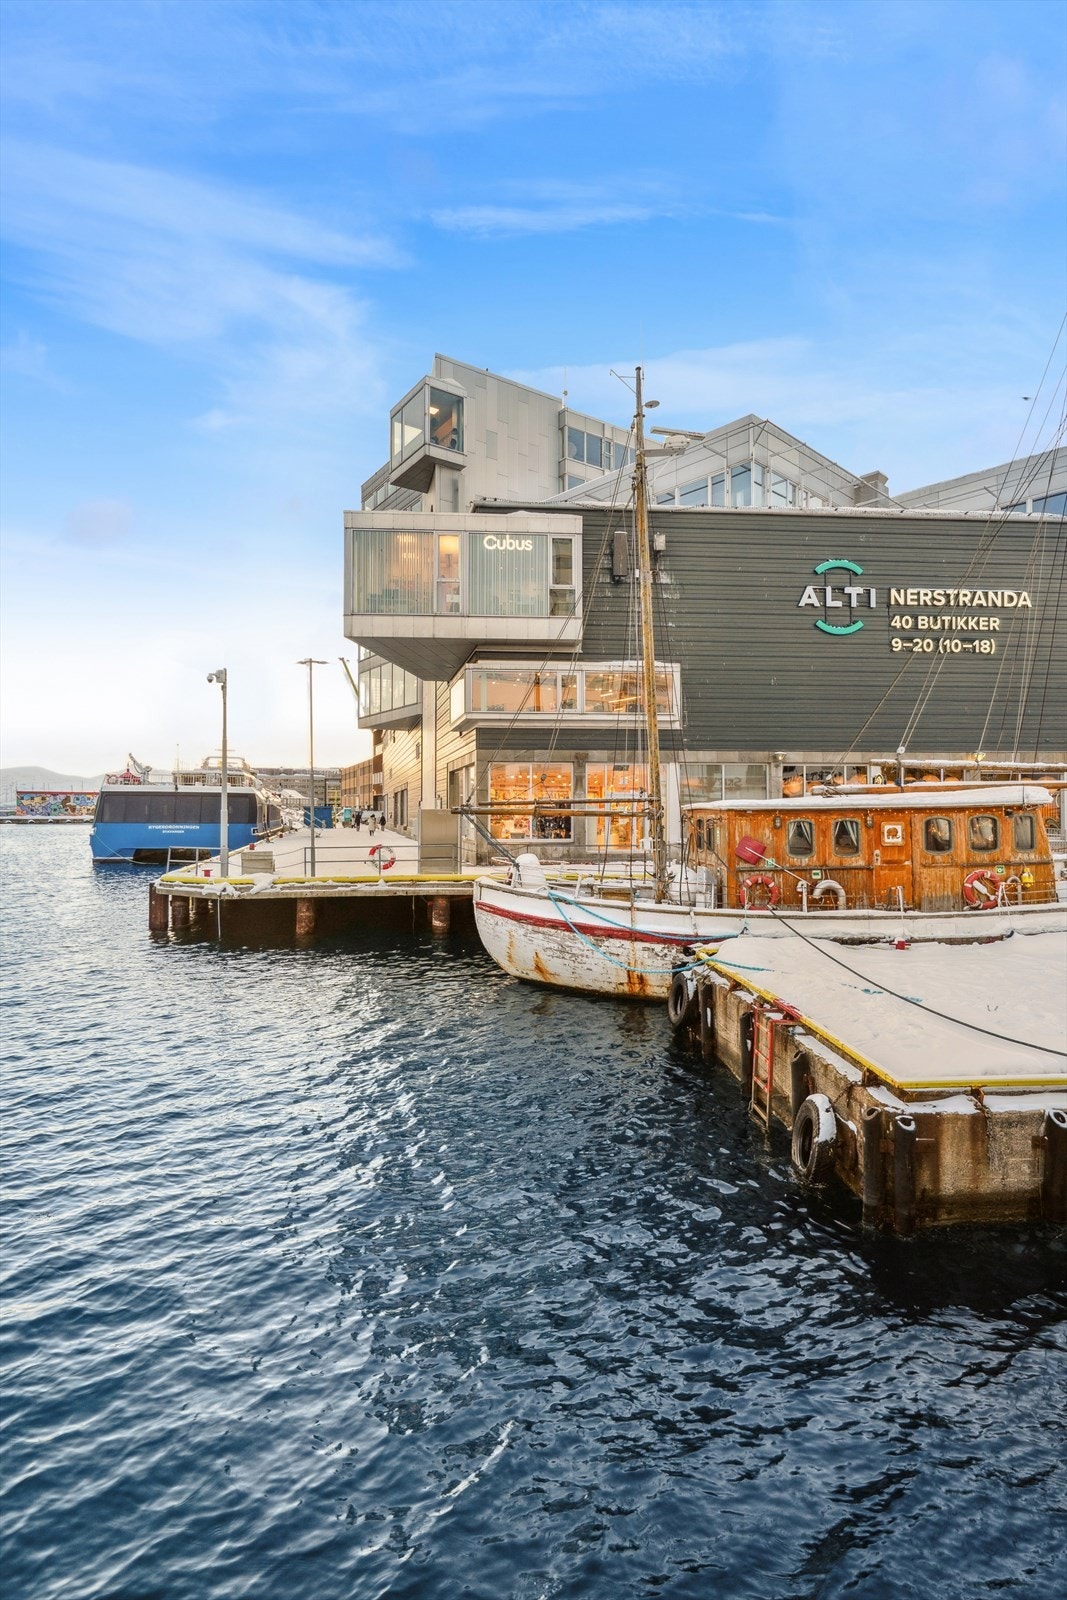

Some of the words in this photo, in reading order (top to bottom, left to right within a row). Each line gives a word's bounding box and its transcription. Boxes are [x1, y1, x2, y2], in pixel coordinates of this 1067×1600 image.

[483, 534, 533, 551] Cubus
[798, 585, 877, 608] ALTI
[889, 587, 1033, 608] NERSTRANDA
[890, 615, 913, 630] 40
[917, 615, 1000, 631] BUTIKKER
